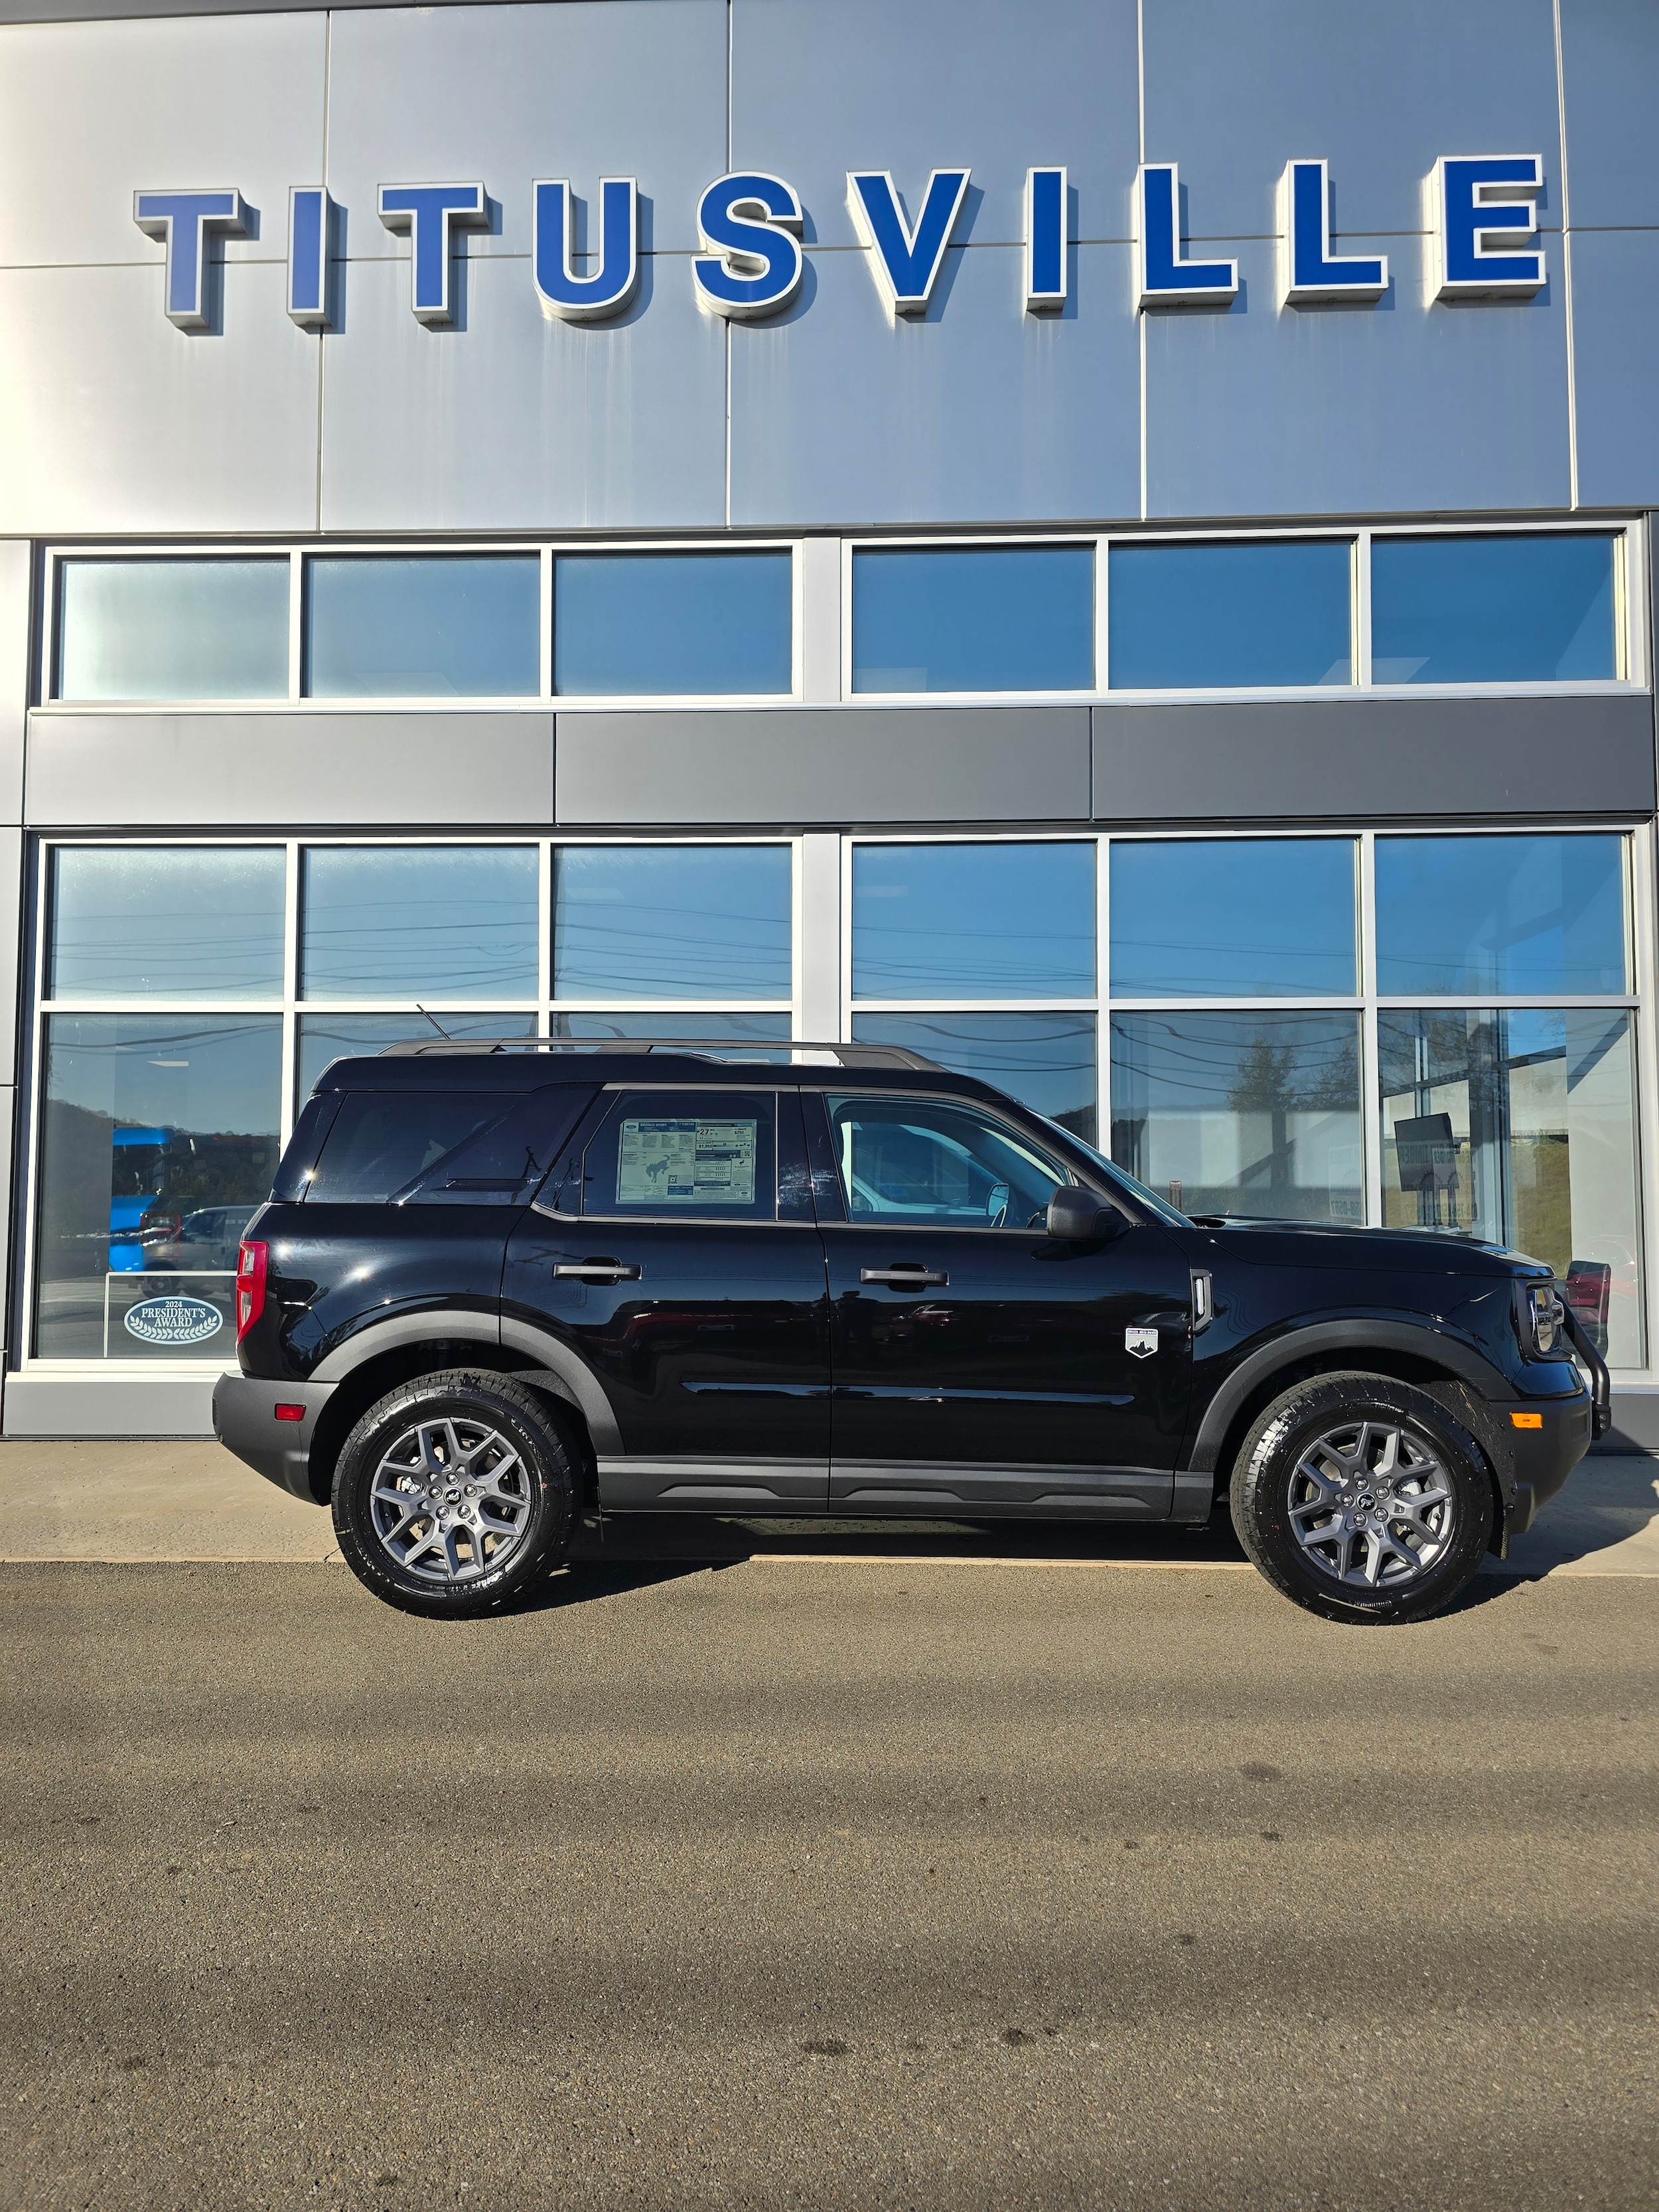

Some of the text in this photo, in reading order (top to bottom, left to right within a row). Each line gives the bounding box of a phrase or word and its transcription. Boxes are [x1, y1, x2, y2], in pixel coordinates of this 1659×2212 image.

[133, 154, 1548, 323] TITUSVILLE
[141, 1307, 206, 1318] PRESIDENT'S
[154, 1317, 192, 1327] AWARD
